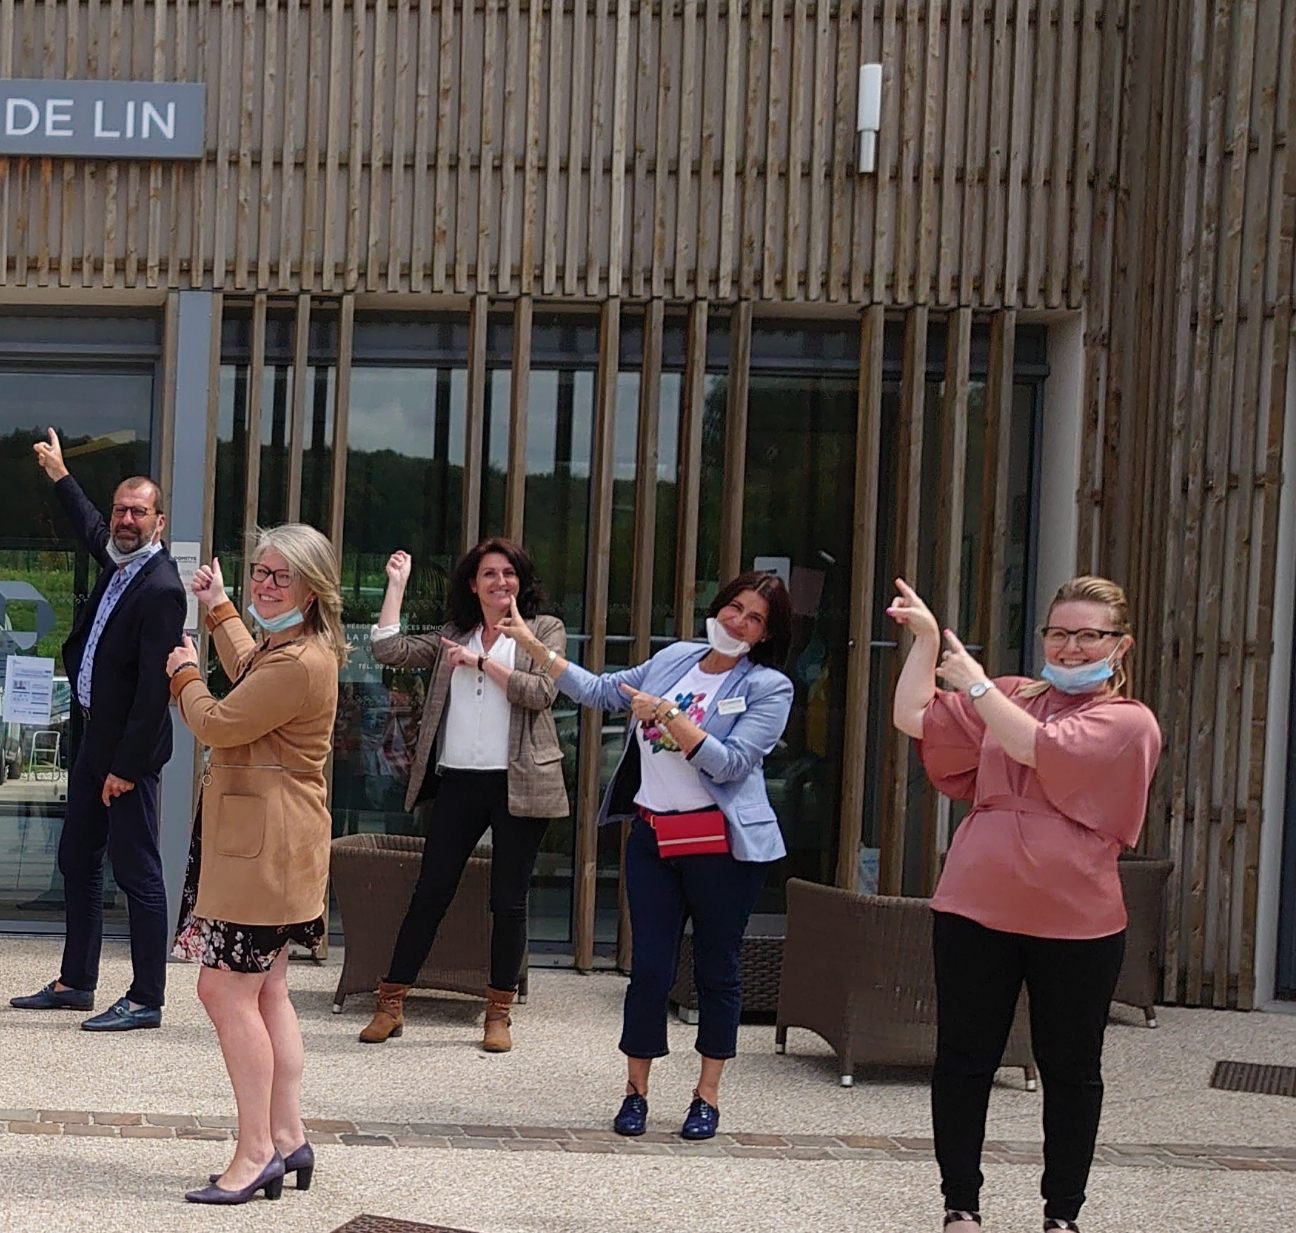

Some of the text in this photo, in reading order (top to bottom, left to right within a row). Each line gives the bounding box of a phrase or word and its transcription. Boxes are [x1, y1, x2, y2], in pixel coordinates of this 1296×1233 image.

[5, 98, 74, 136] DE
[94, 100, 175, 139] LIN
[422, 623, 443, 631] SÉNIO
